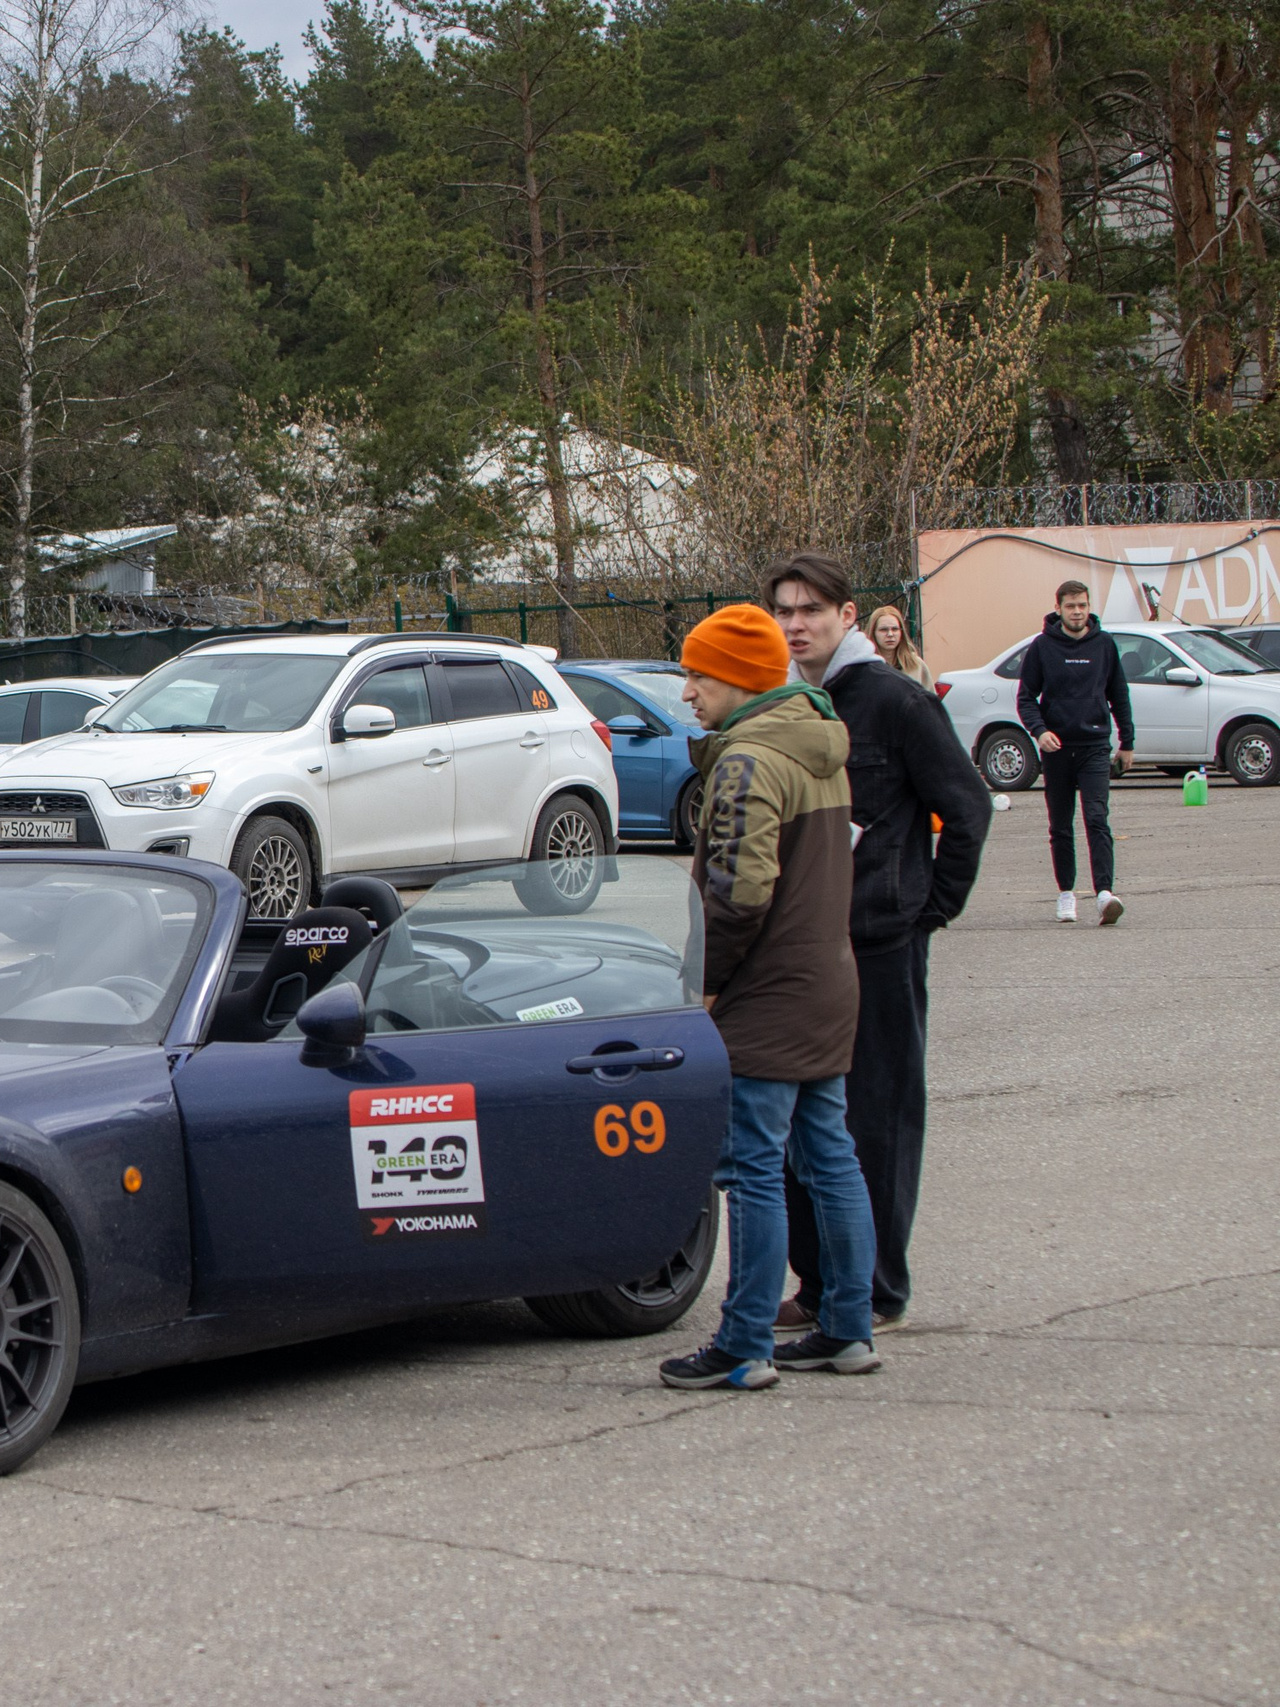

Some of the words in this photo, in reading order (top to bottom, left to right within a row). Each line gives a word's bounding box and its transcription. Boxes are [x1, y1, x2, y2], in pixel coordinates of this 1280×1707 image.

[532, 690, 549, 709] 49
[53, 821, 71, 834] 777
[285, 926, 349, 946] sparco
[522, 1005, 557, 1021] GREEN
[556, 1001, 578, 1015] ERA
[370, 1094, 454, 1117] RHHCC
[594, 1100, 666, 1157] 69
[376, 1155, 425, 1168] GREEN
[430, 1153, 459, 1165] ERA
[395, 1214, 478, 1232] YOKOHAMA
